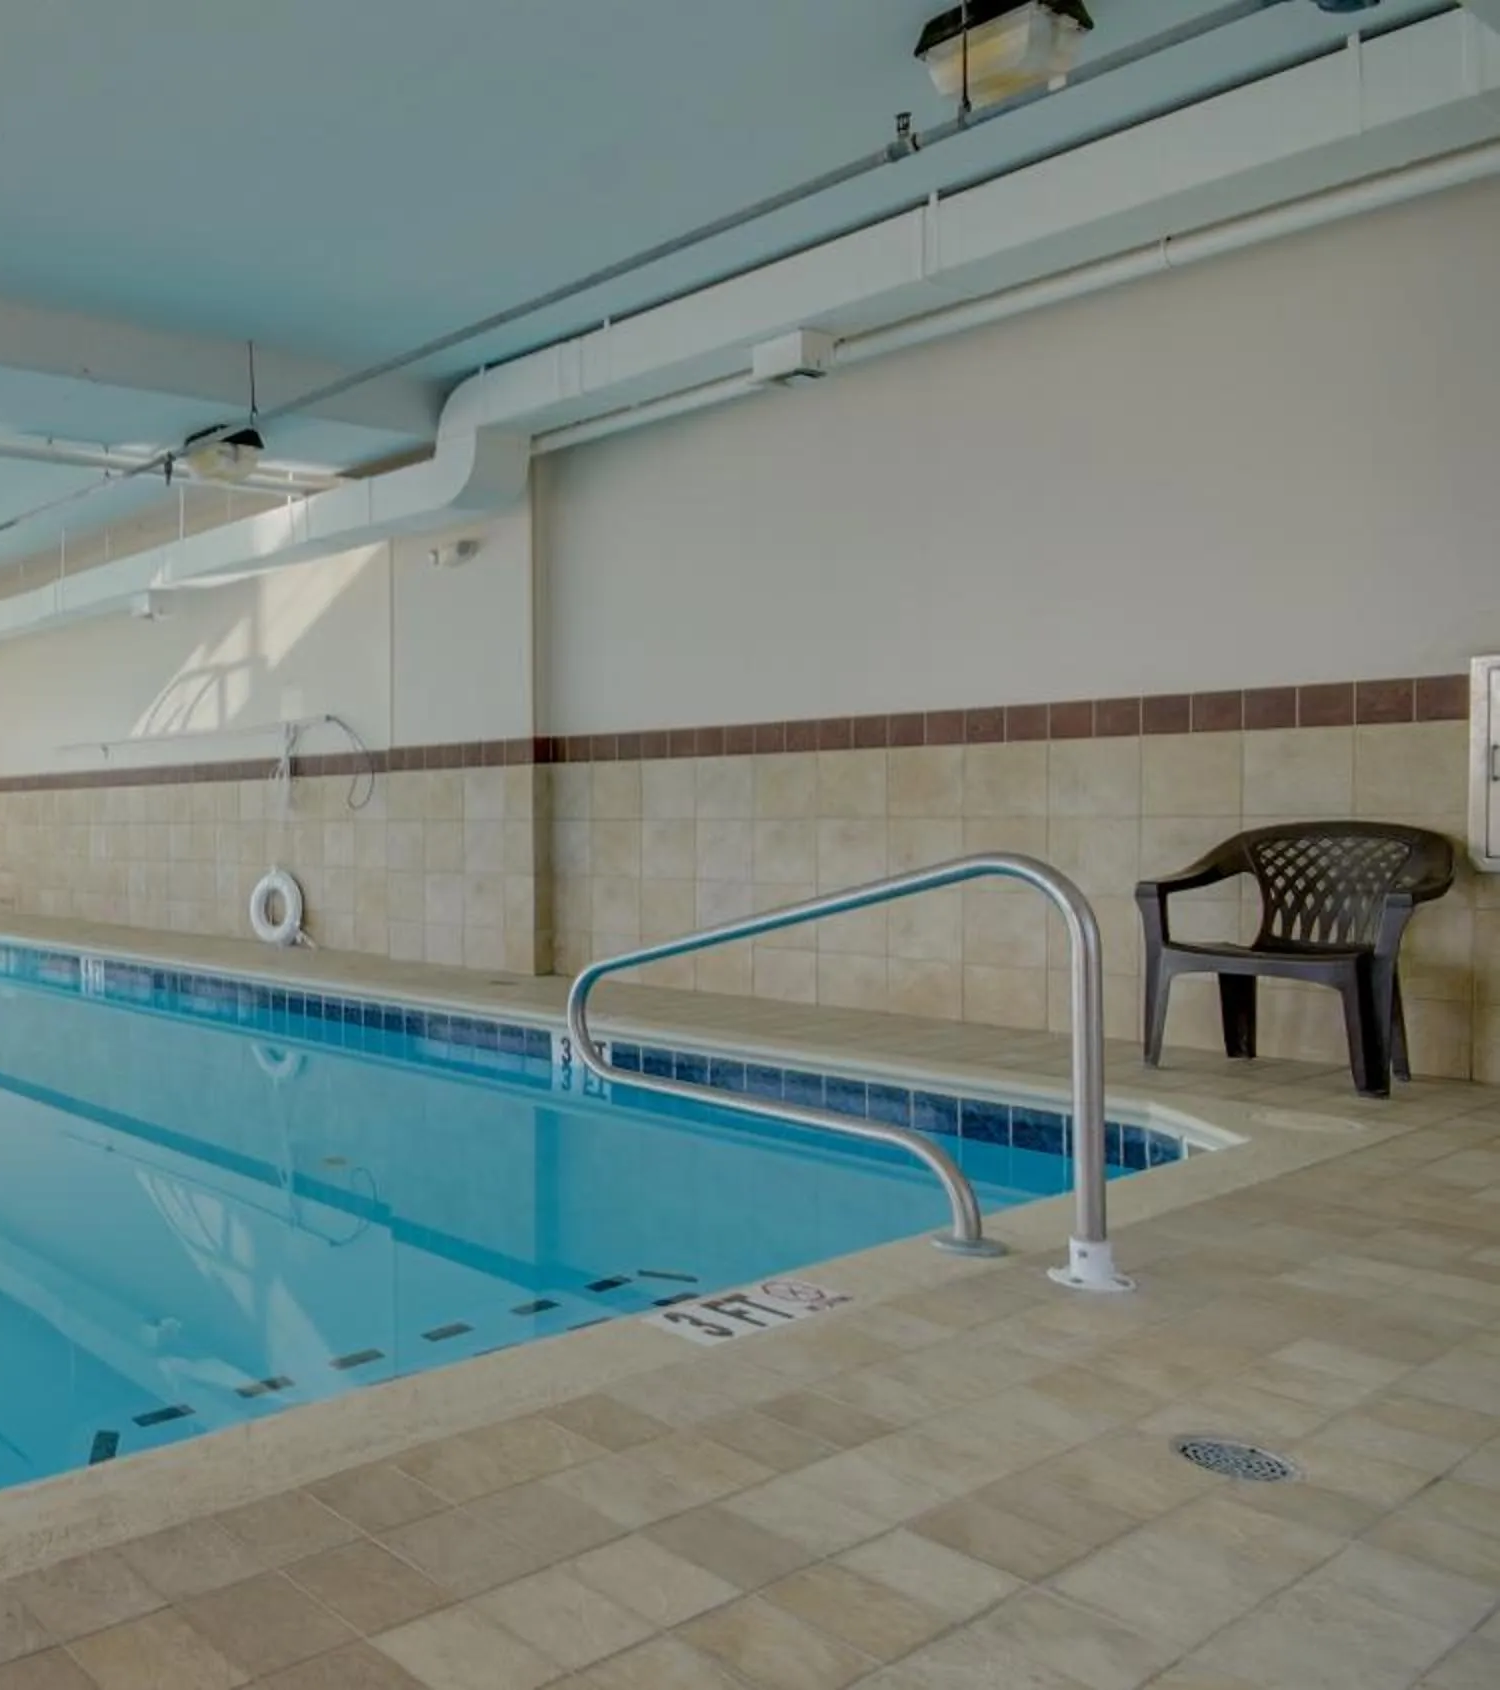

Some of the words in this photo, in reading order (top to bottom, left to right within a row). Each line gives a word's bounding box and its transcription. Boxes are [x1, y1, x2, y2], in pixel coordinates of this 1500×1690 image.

[561, 1037, 572, 1065] 3
[663, 1311, 734, 1337] 3
[701, 1292, 795, 1328] FT
